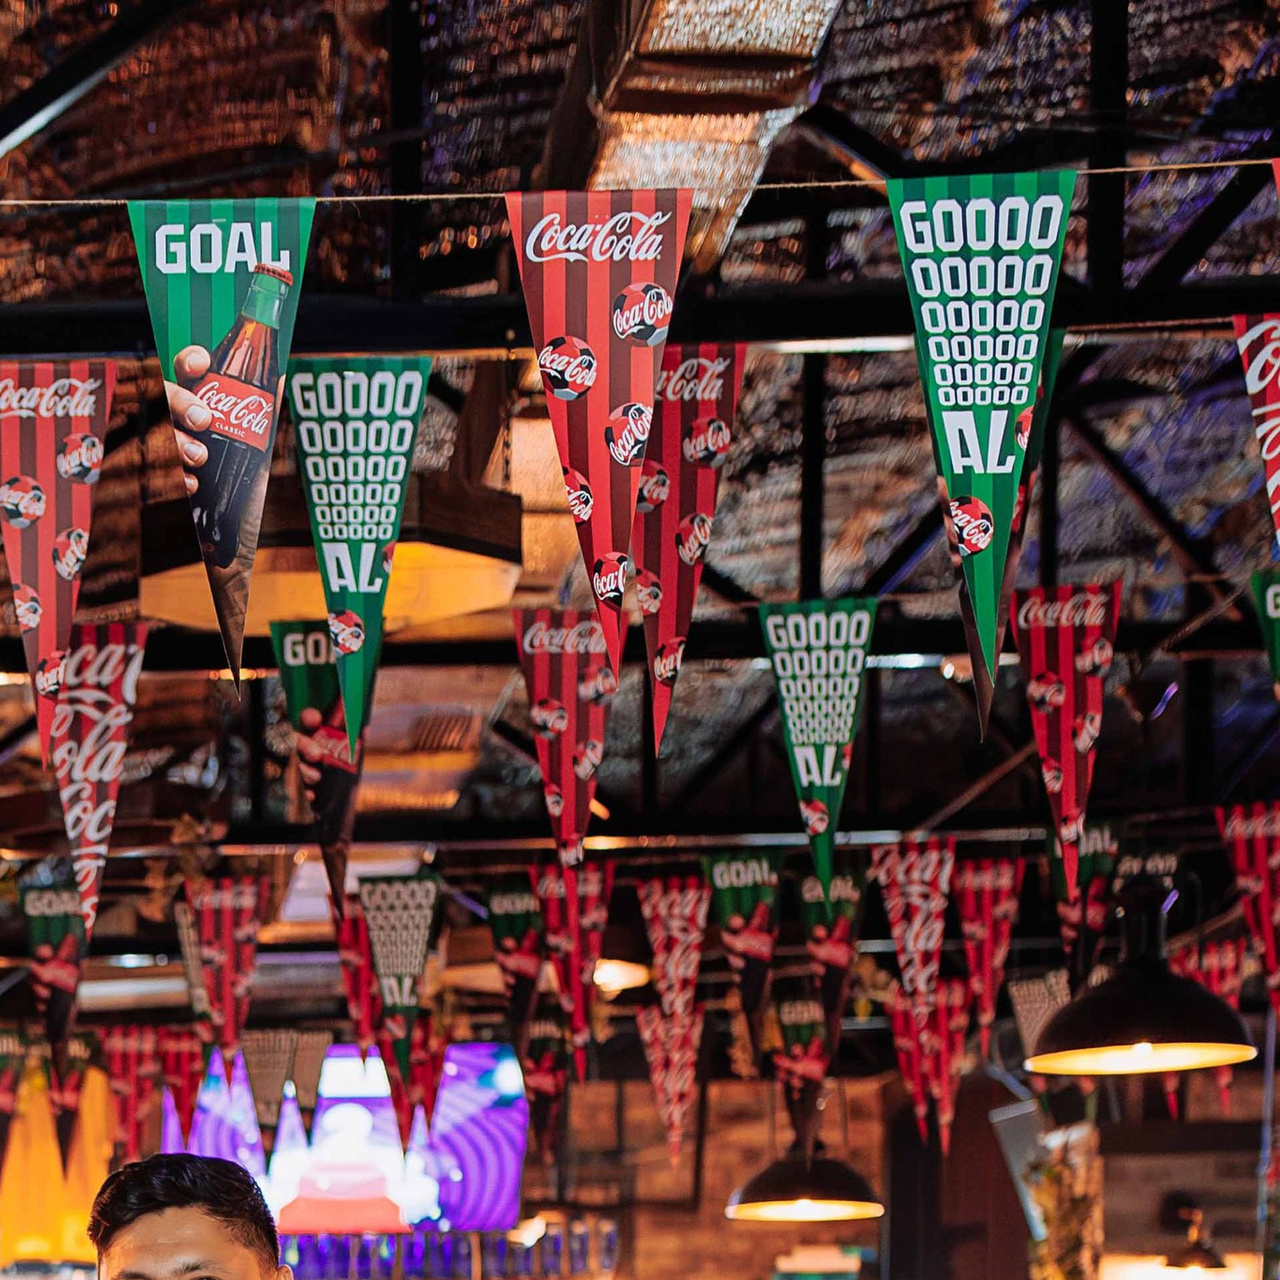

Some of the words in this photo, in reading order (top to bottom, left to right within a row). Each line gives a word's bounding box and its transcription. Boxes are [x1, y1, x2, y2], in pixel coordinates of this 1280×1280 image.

[526, 211, 672, 263] Coca-Cola
[900, 195, 1063, 253] GOOOO
[155, 221, 290, 274] GOAL
[911, 254, 1053, 297] OOOOO
[921, 299, 1045, 333] OOOOO
[928, 333, 1039, 361] OOOOO
[933, 361, 1032, 385] OOOOO
[291, 369, 422, 418] GOOOO
[938, 385, 1029, 405] OOOOO
[299, 419, 413, 453] OOOOO
[942, 409, 1015, 474] AL
[305, 455, 406, 482] OOOOO
[310, 483, 401, 505] OOOOO
[314, 505, 396, 524] OOOOO
[319, 523, 392, 540] OOOOO
[322, 542, 382, 593] AL
[766, 610, 871, 650] GOOOO
[773, 648, 865, 678] OOOOO
[779, 676, 860, 700] OOOOO
[794, 744, 842, 788] AL
